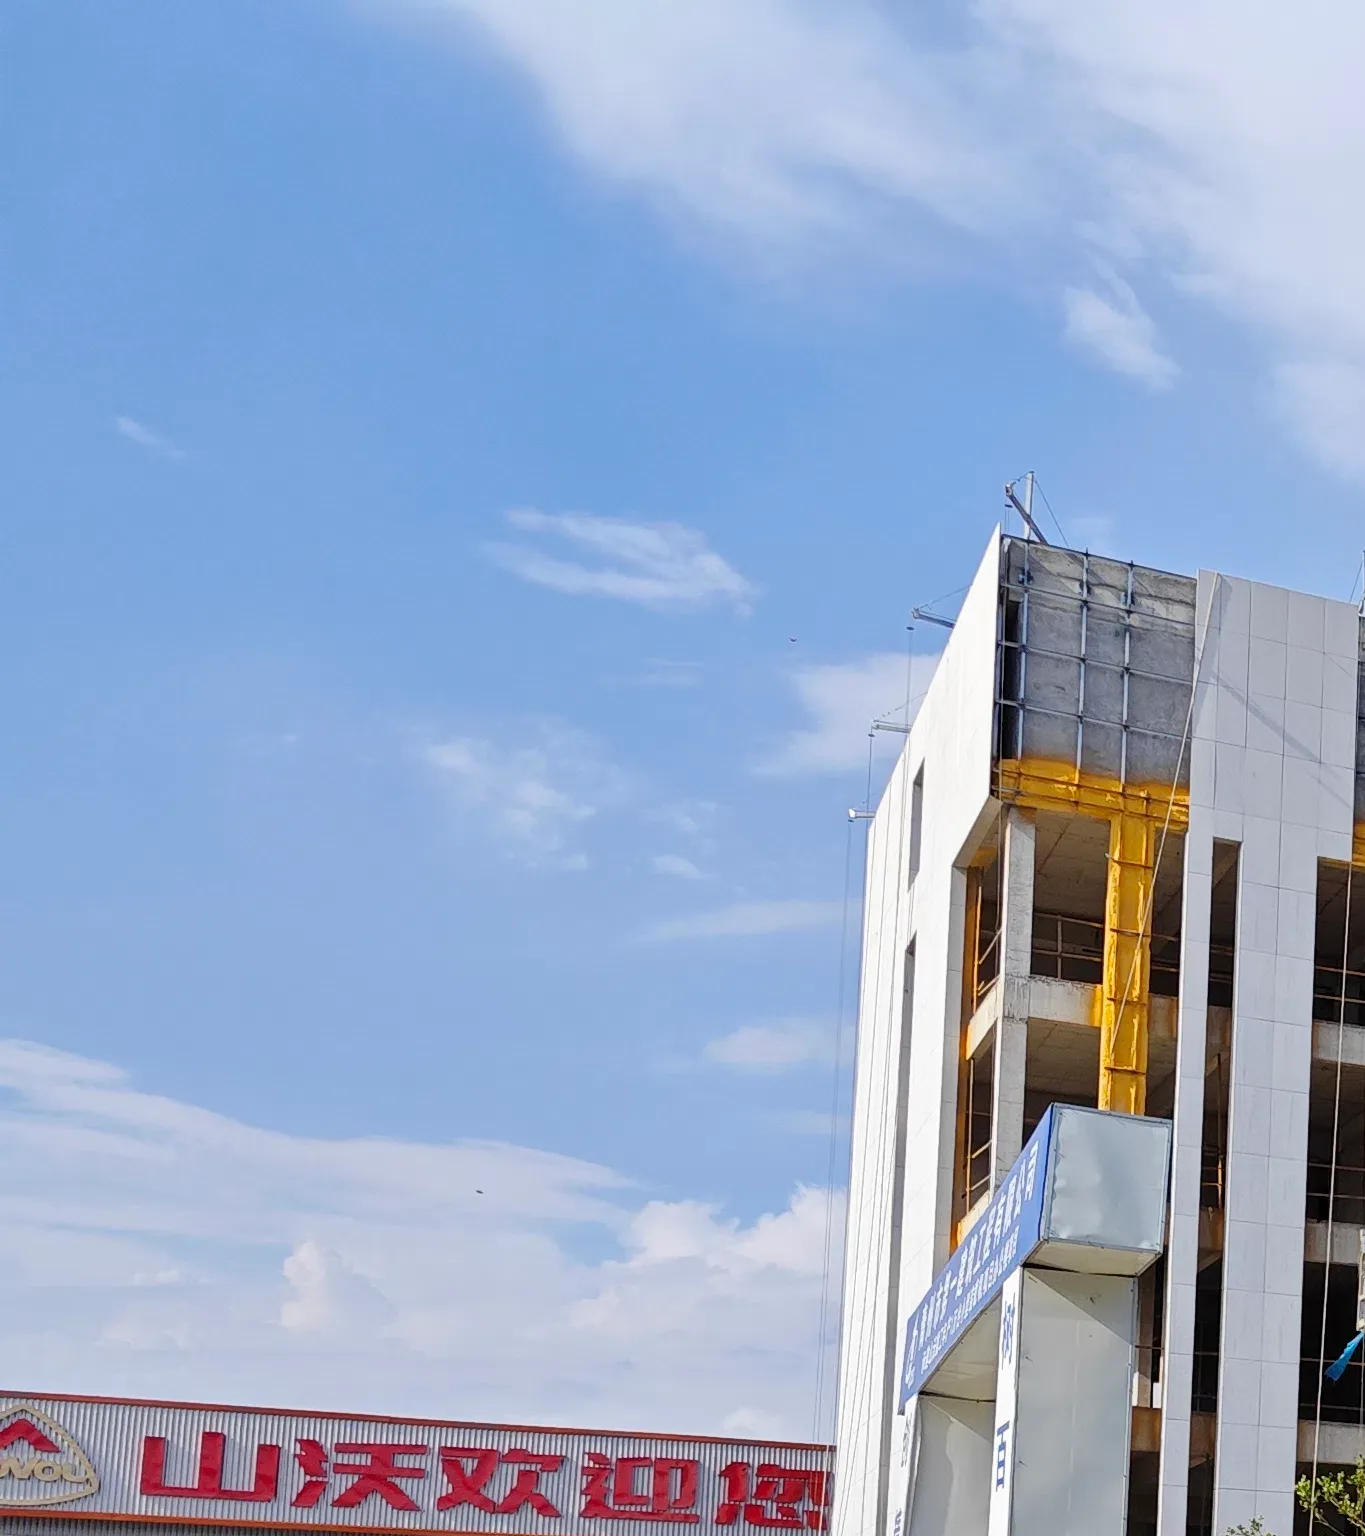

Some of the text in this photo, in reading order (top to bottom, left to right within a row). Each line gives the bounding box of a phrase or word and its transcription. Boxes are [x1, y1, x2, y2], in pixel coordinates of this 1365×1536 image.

[140, 1431, 830, 1530] 山沃欢迎您
